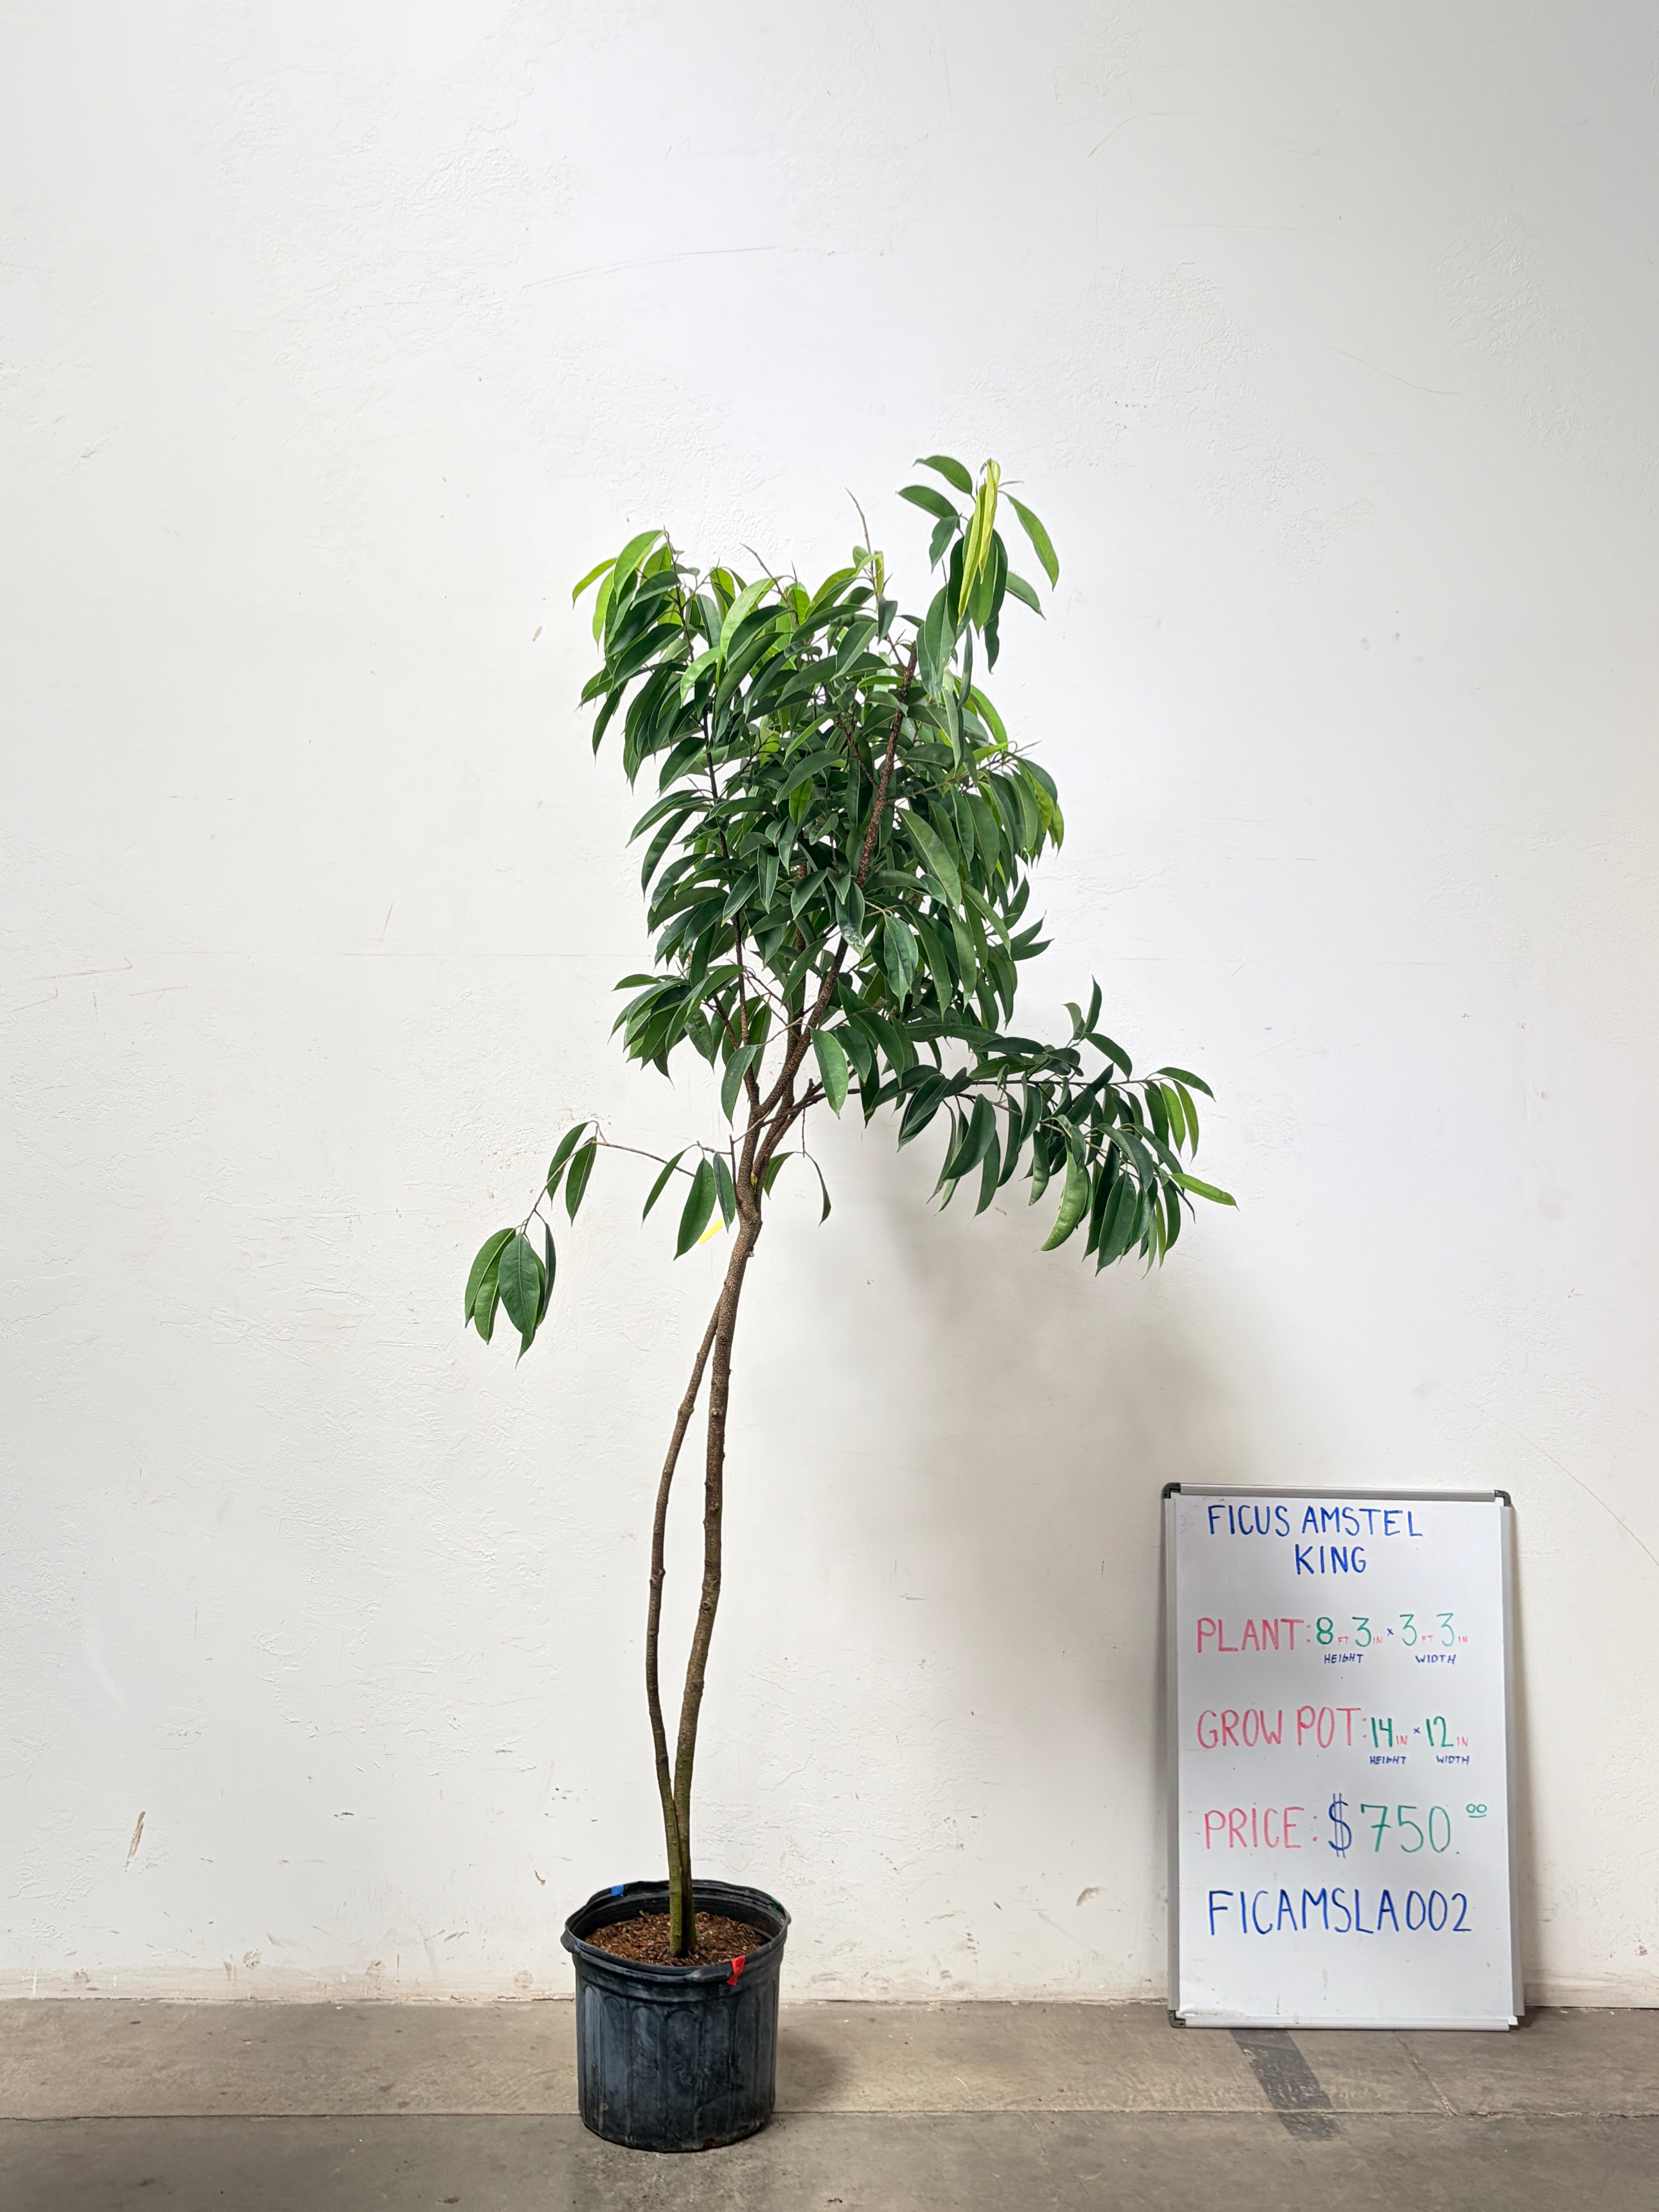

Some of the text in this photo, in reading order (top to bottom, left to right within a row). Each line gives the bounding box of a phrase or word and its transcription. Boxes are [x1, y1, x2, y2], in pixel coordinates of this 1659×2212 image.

[1207, 1504, 1424, 1538] FICUS AMSTEL
[1294, 1544, 1367, 1576] KING
[1196, 1617, 1310, 1654] PLANT:
[1315, 1617, 1334, 1646] 8
[1352, 1616, 1372, 1647] 3
[1399, 1614, 1417, 1646] 3
[1436, 1612, 1455, 1647] 3
[1324, 1653, 1456, 1665] HEIGHT WIDTH
[1196, 1709, 1283, 1750] GROW
[1296, 1705, 1367, 1749] POT:
[1370, 1717, 1394, 1748] 14
[1425, 1716, 1454, 1748] 12
[1369, 1755, 1470, 1766] HEIGHT WIDTH
[1204, 1802, 1318, 1850] PRICE:
[1208, 1887, 1473, 1936] FICAMSLA002
